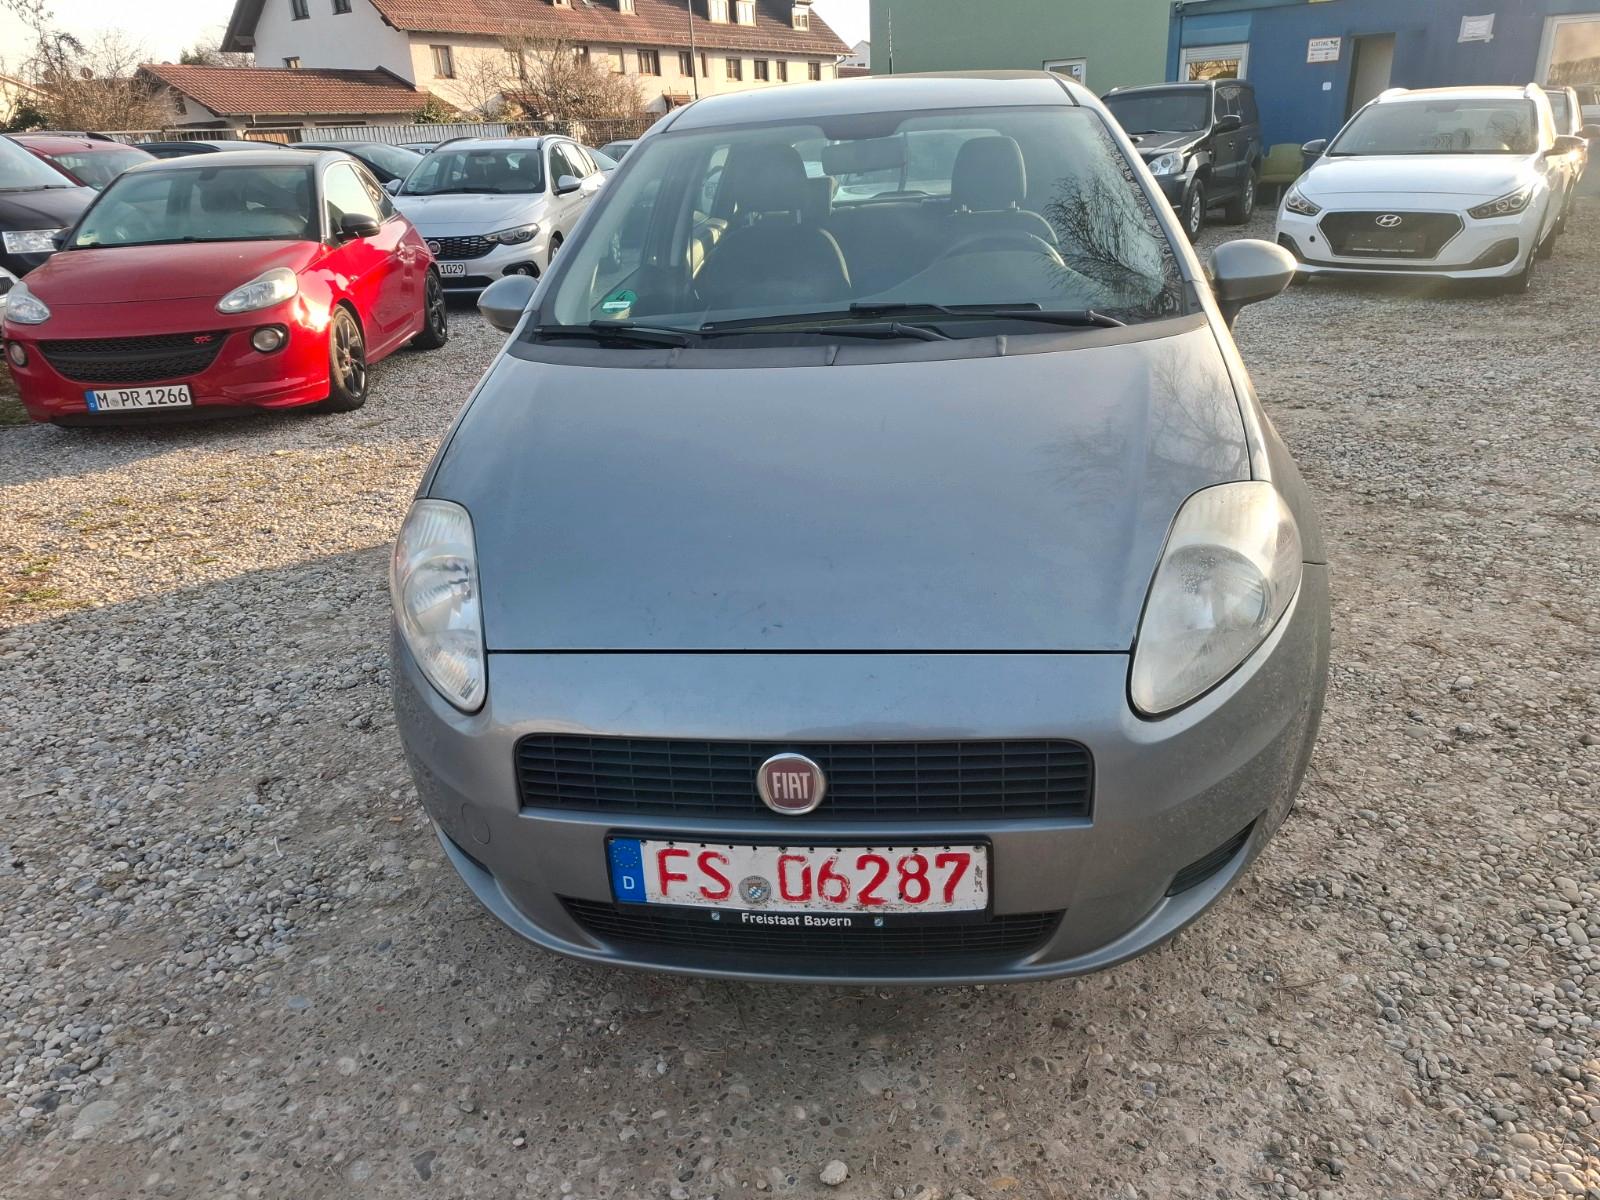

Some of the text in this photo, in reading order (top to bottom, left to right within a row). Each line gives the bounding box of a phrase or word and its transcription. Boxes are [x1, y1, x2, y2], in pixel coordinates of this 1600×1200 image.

[440, 264, 464, 274] 1029
[96, 387, 188, 408] M PR 1266
[772, 772, 810, 799] FIAT
[622, 875, 635, 890] D
[656, 848, 732, 900] FS
[776, 852, 971, 905] 06287
[741, 912, 852, 927] Freistaat Bayern
